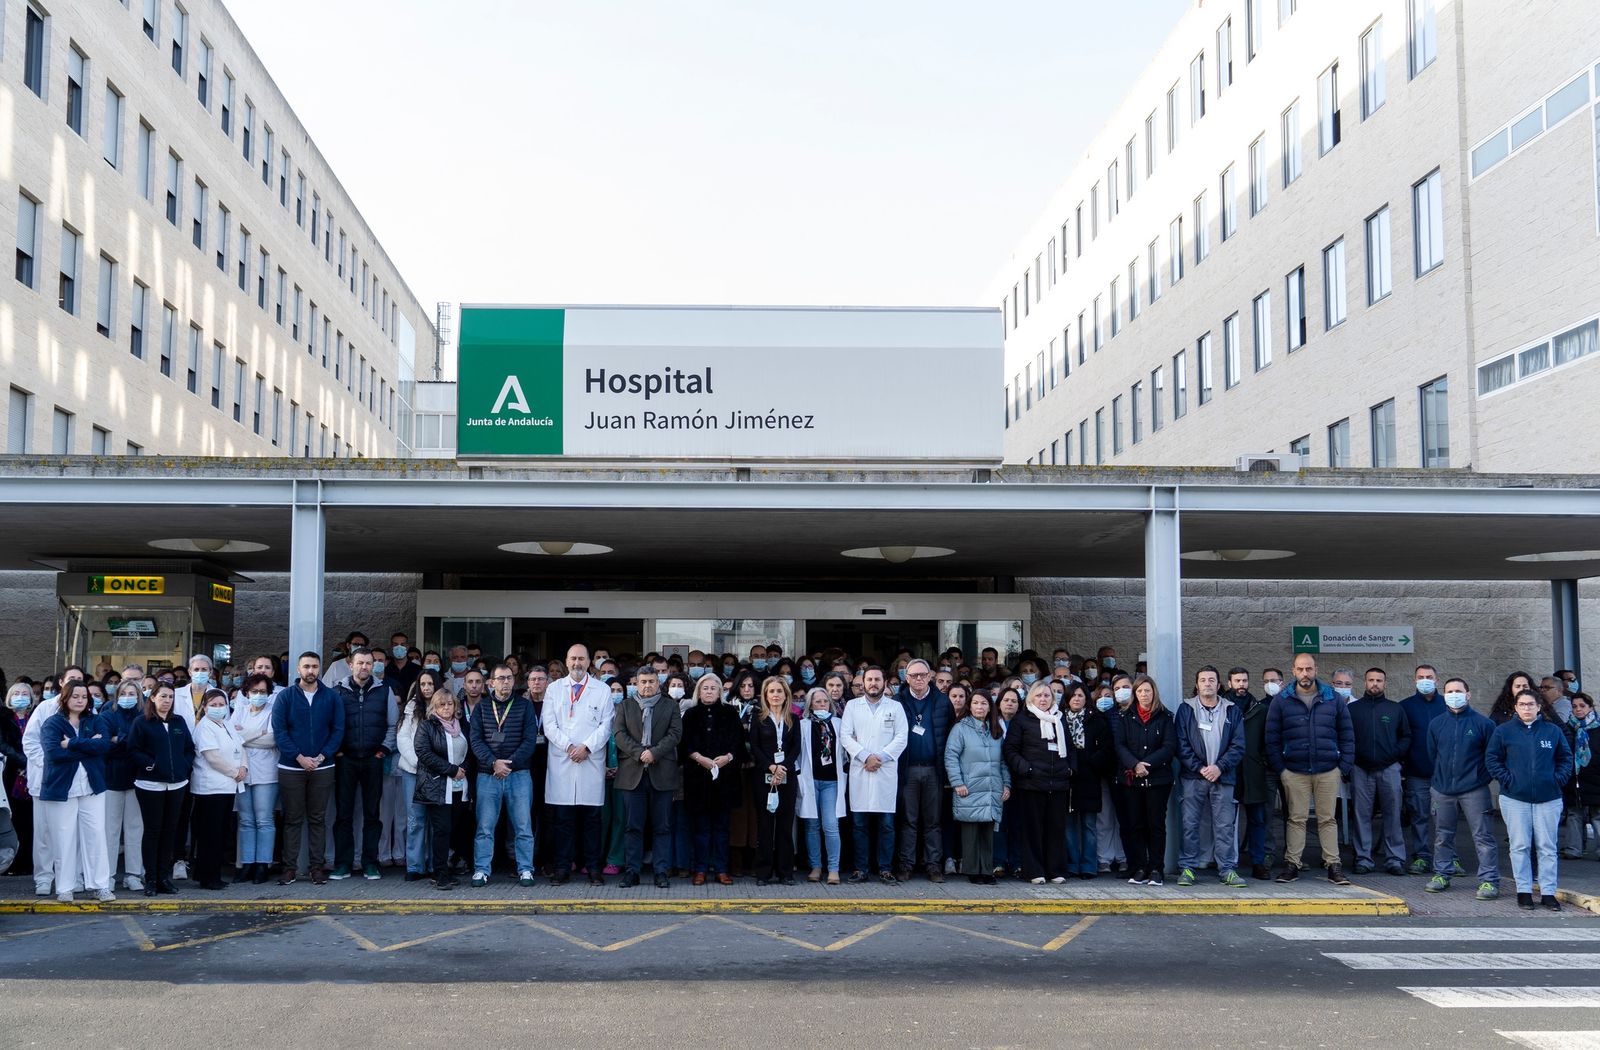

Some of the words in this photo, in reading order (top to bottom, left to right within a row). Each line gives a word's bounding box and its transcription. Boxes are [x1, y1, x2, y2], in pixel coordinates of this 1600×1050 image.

[584, 366, 714, 400] Hospital
[466, 416, 493, 426] Junta
[494, 416, 506, 426] de
[508, 416, 554, 427] Andalucía
[584, 411, 636, 430] Juan
[644, 408, 718, 430] Ramón
[725, 408, 814, 430] Jiménez
[110, 579, 158, 591] ONCE
[214, 586, 231, 600] ONCE
[1323, 634, 1356, 642] Donación
[1368, 634, 1394, 642] Sangre
